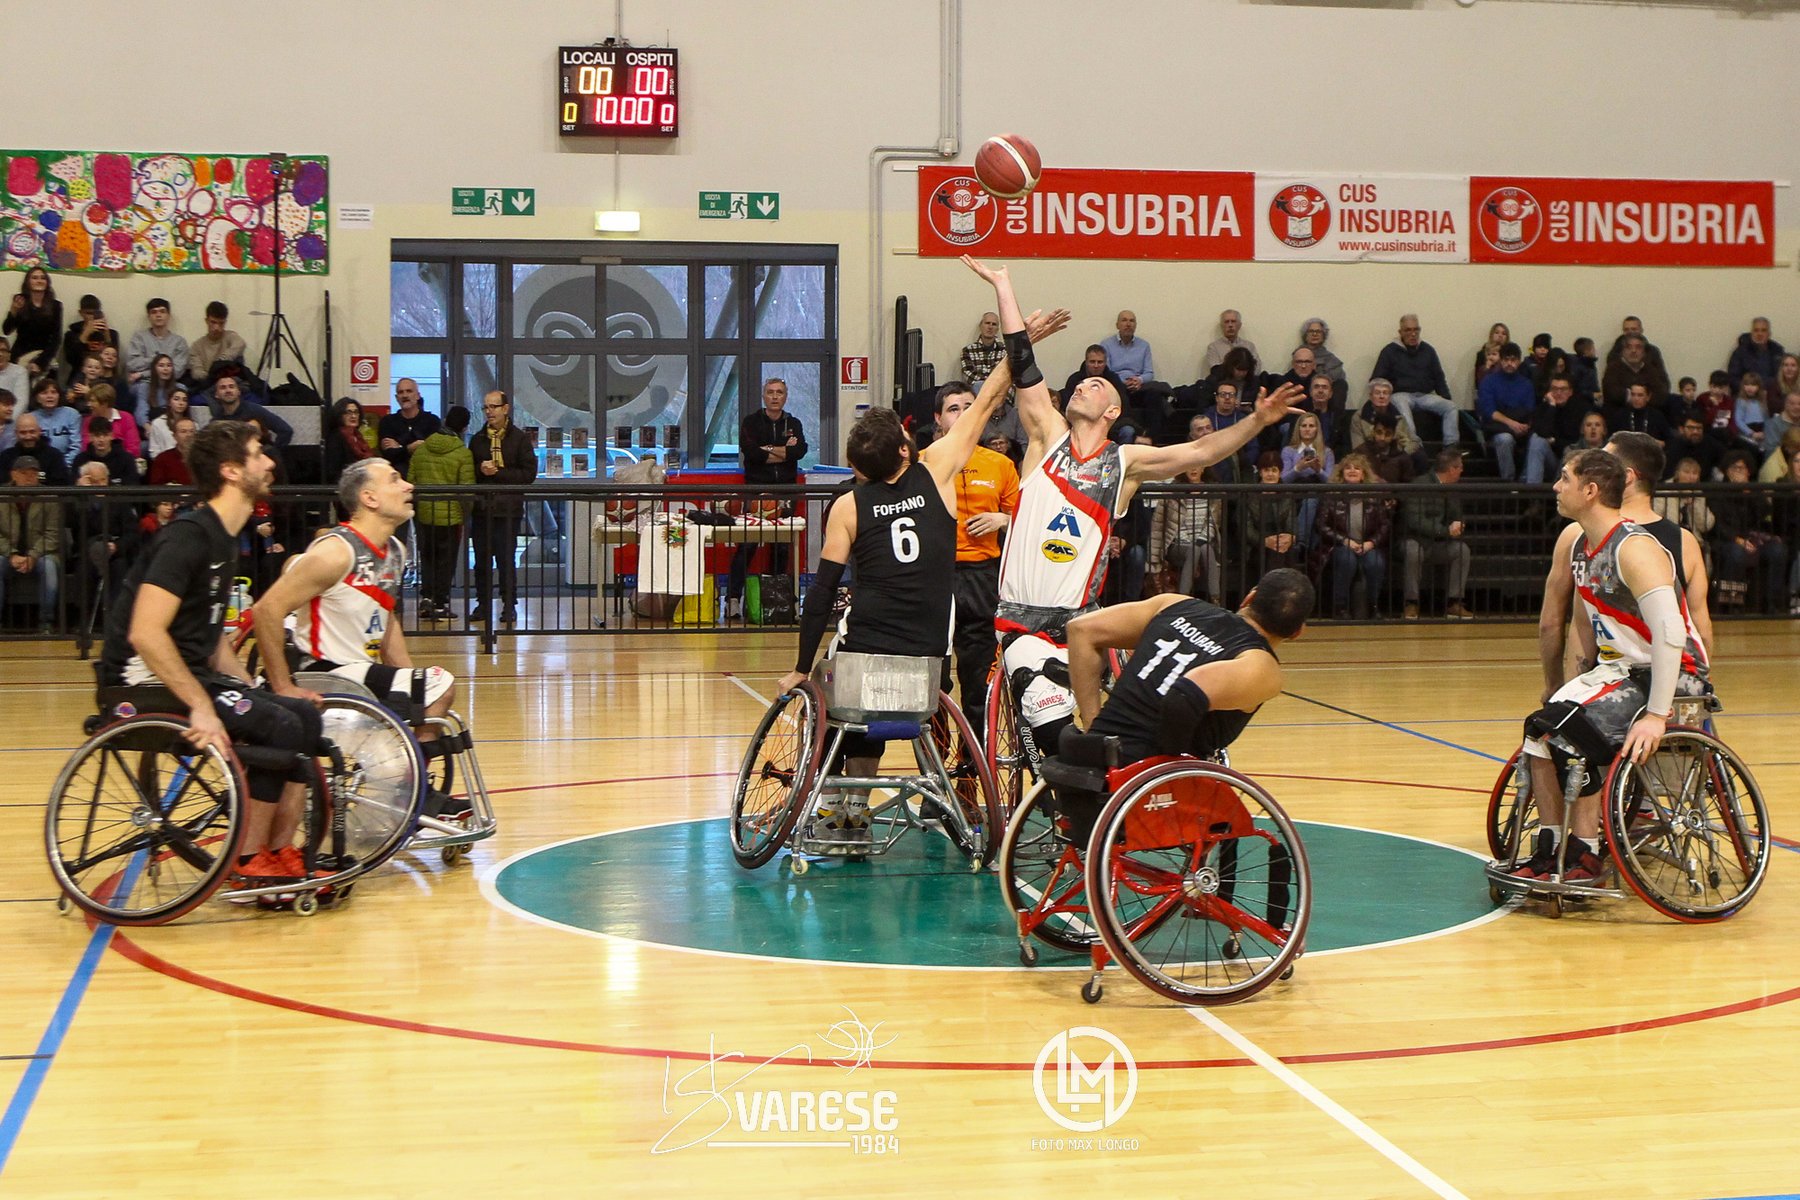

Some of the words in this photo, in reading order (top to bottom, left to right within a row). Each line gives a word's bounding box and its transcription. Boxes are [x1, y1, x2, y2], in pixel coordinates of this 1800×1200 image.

[563, 52, 616, 65] LOCALI
[626, 53, 674, 66] OSPITI
[578, 66, 613, 95] 00
[635, 67, 669, 95] 00
[564, 102, 577, 123] 0
[660, 103, 675, 125] 0
[954, 179, 971, 187] CUS
[1338, 184, 1377, 203] CUS
[1032, 191, 1242, 237] INSUBRIA
[1339, 209, 1456, 234] INSUBRIA
[1550, 200, 1570, 242] CUS
[1573, 201, 1766, 245] INSUBRIA
[945, 233, 981, 243] INSUBRIA
[1338, 239, 1457, 253] www.cusinsubria.it
[1048, 450, 1071, 481] 19
[872, 494, 926, 518] FOFFANO
[890, 516, 920, 564] 6
[352, 561, 375, 587] 25
[1571, 561, 1586, 587] 33
[1137, 638, 1199, 696] 11
[1036, 693, 1066, 709] VARESE
